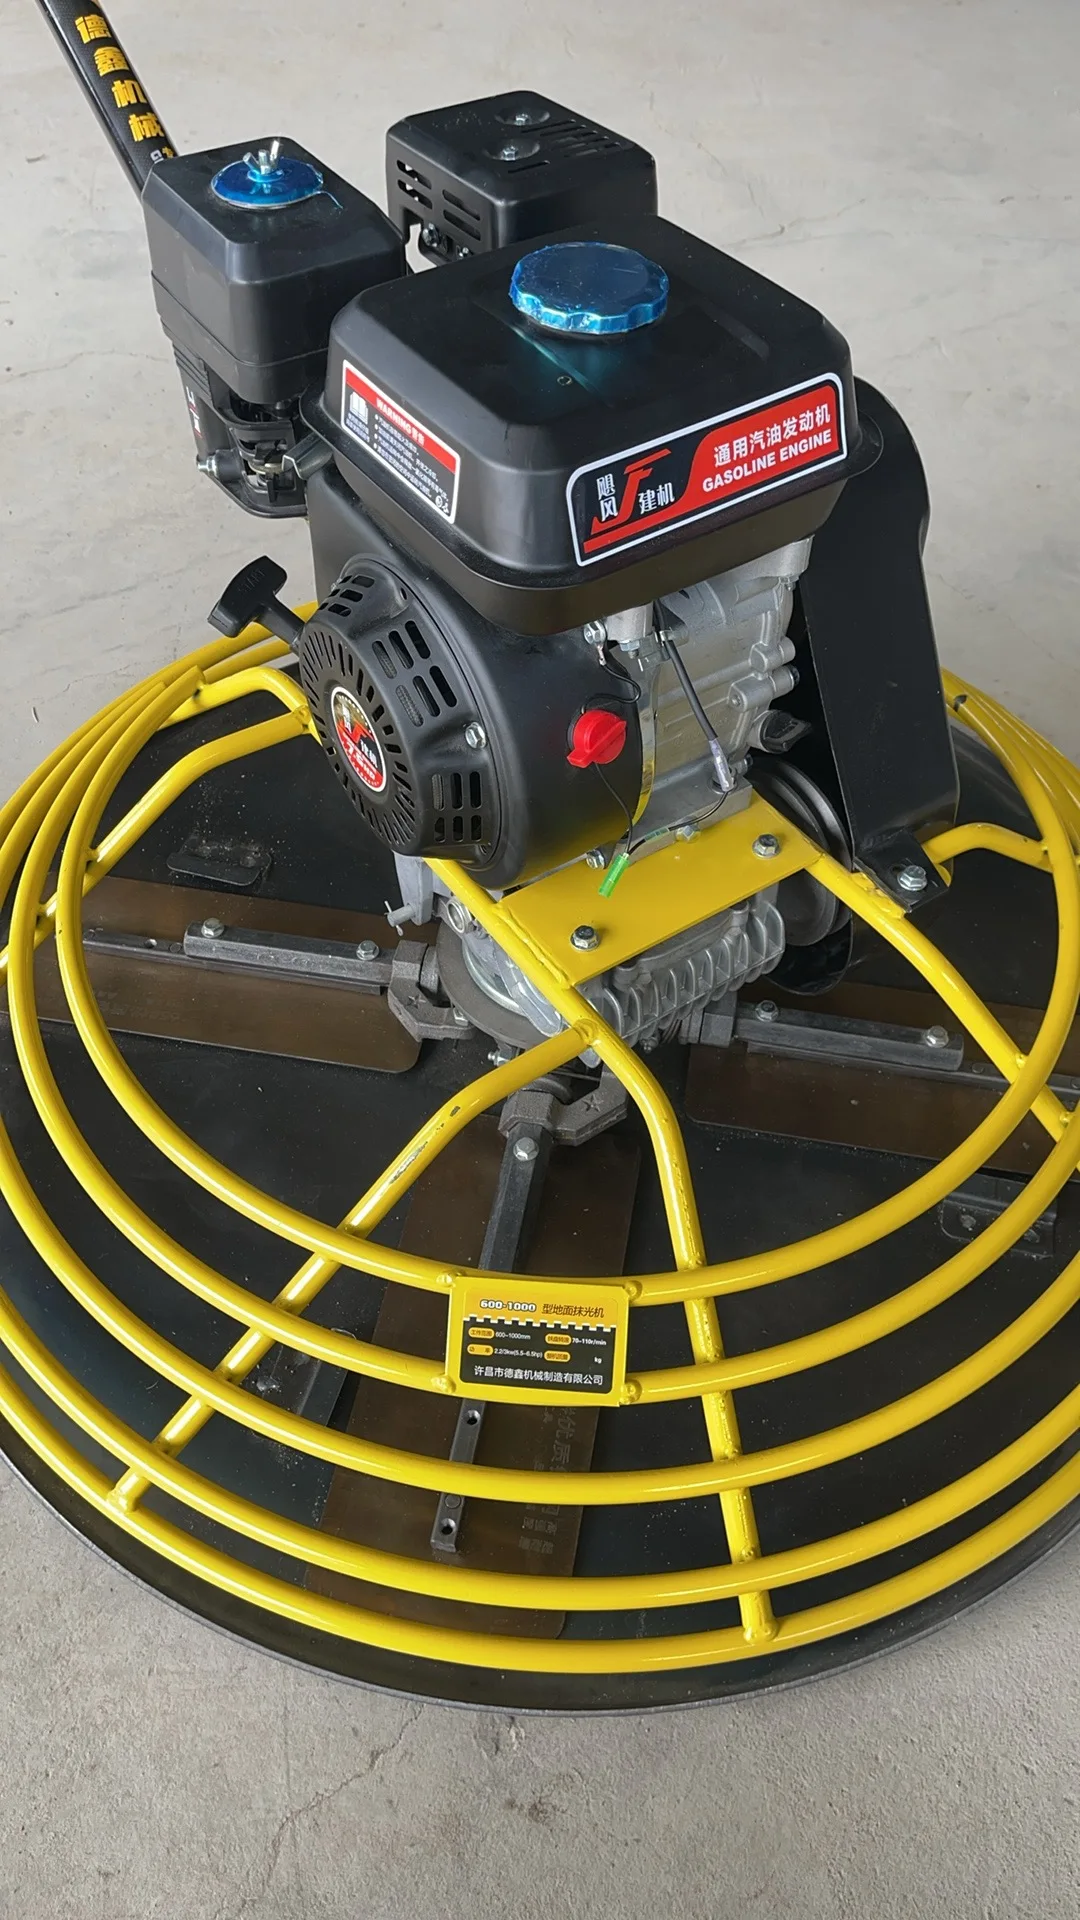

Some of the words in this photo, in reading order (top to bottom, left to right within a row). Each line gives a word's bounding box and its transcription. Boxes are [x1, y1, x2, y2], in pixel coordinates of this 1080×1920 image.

[376, 397, 412, 433] WARNING
[713, 403, 831, 468] 通用汽油发动机
[702, 453, 777, 493] GASOLINE
[779, 428, 832, 463] ENGINE
[638, 482, 675, 515] 建机
[480, 1299, 536, 1312] 600-1000
[542, 1303, 604, 1318] 型地面抹光机
[474, 1365, 603, 1385] 许昌市德鑫机械制造有限公司
